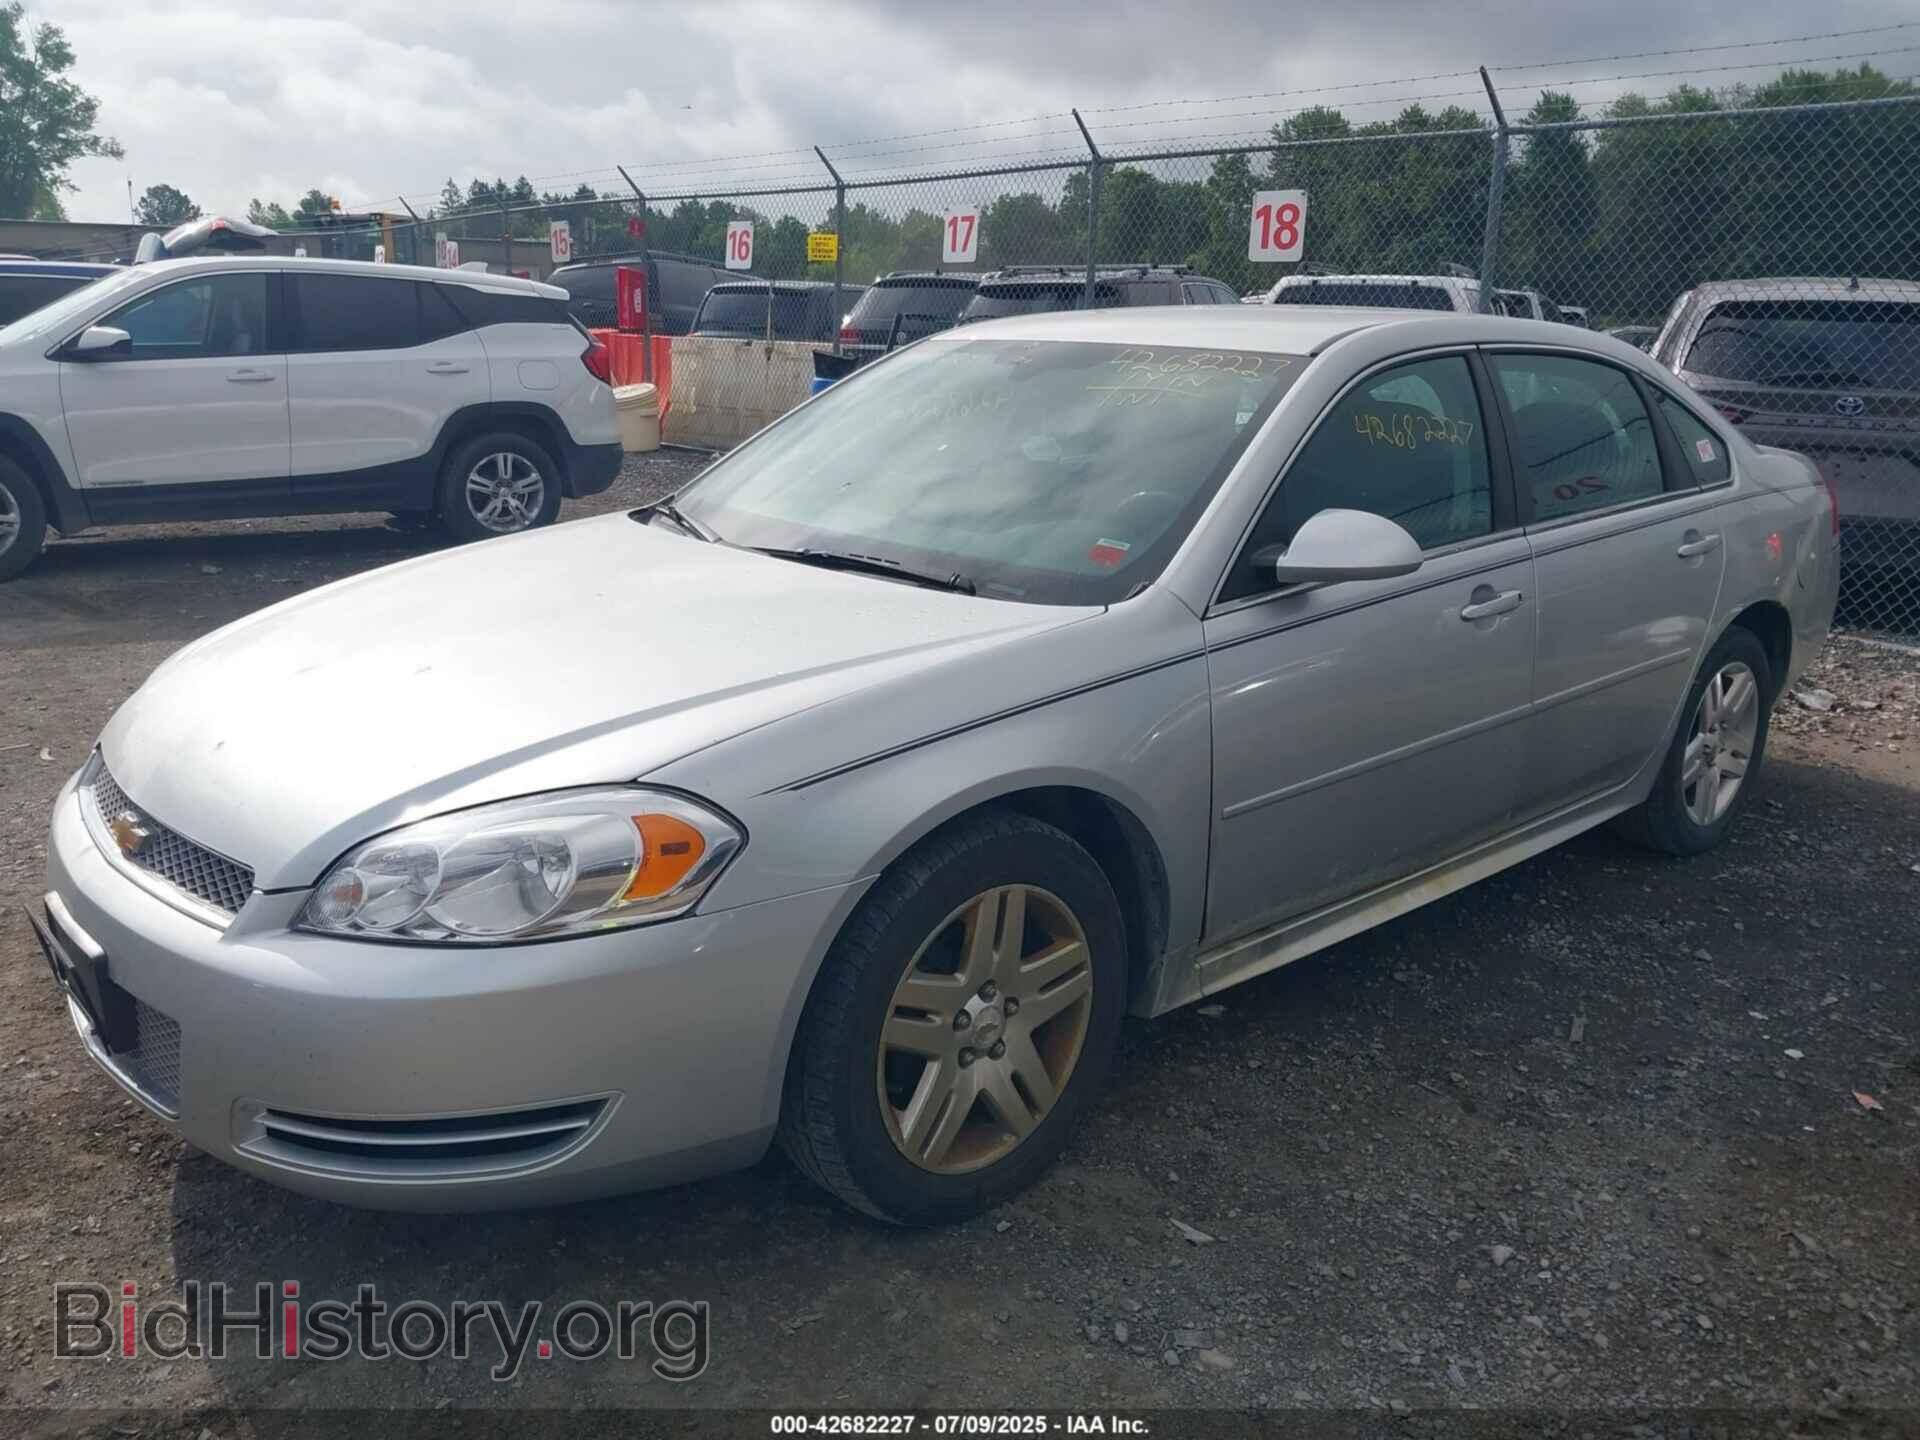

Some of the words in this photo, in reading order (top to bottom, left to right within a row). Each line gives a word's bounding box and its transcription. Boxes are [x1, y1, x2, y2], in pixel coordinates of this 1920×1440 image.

[552, 229, 568, 255] 15
[948, 215, 975, 252] 17
[1256, 203, 1300, 250] 18
[729, 230, 750, 261] 16
[1112, 349, 1291, 378] 42682227
[1355, 414, 1473, 449] 42682227
